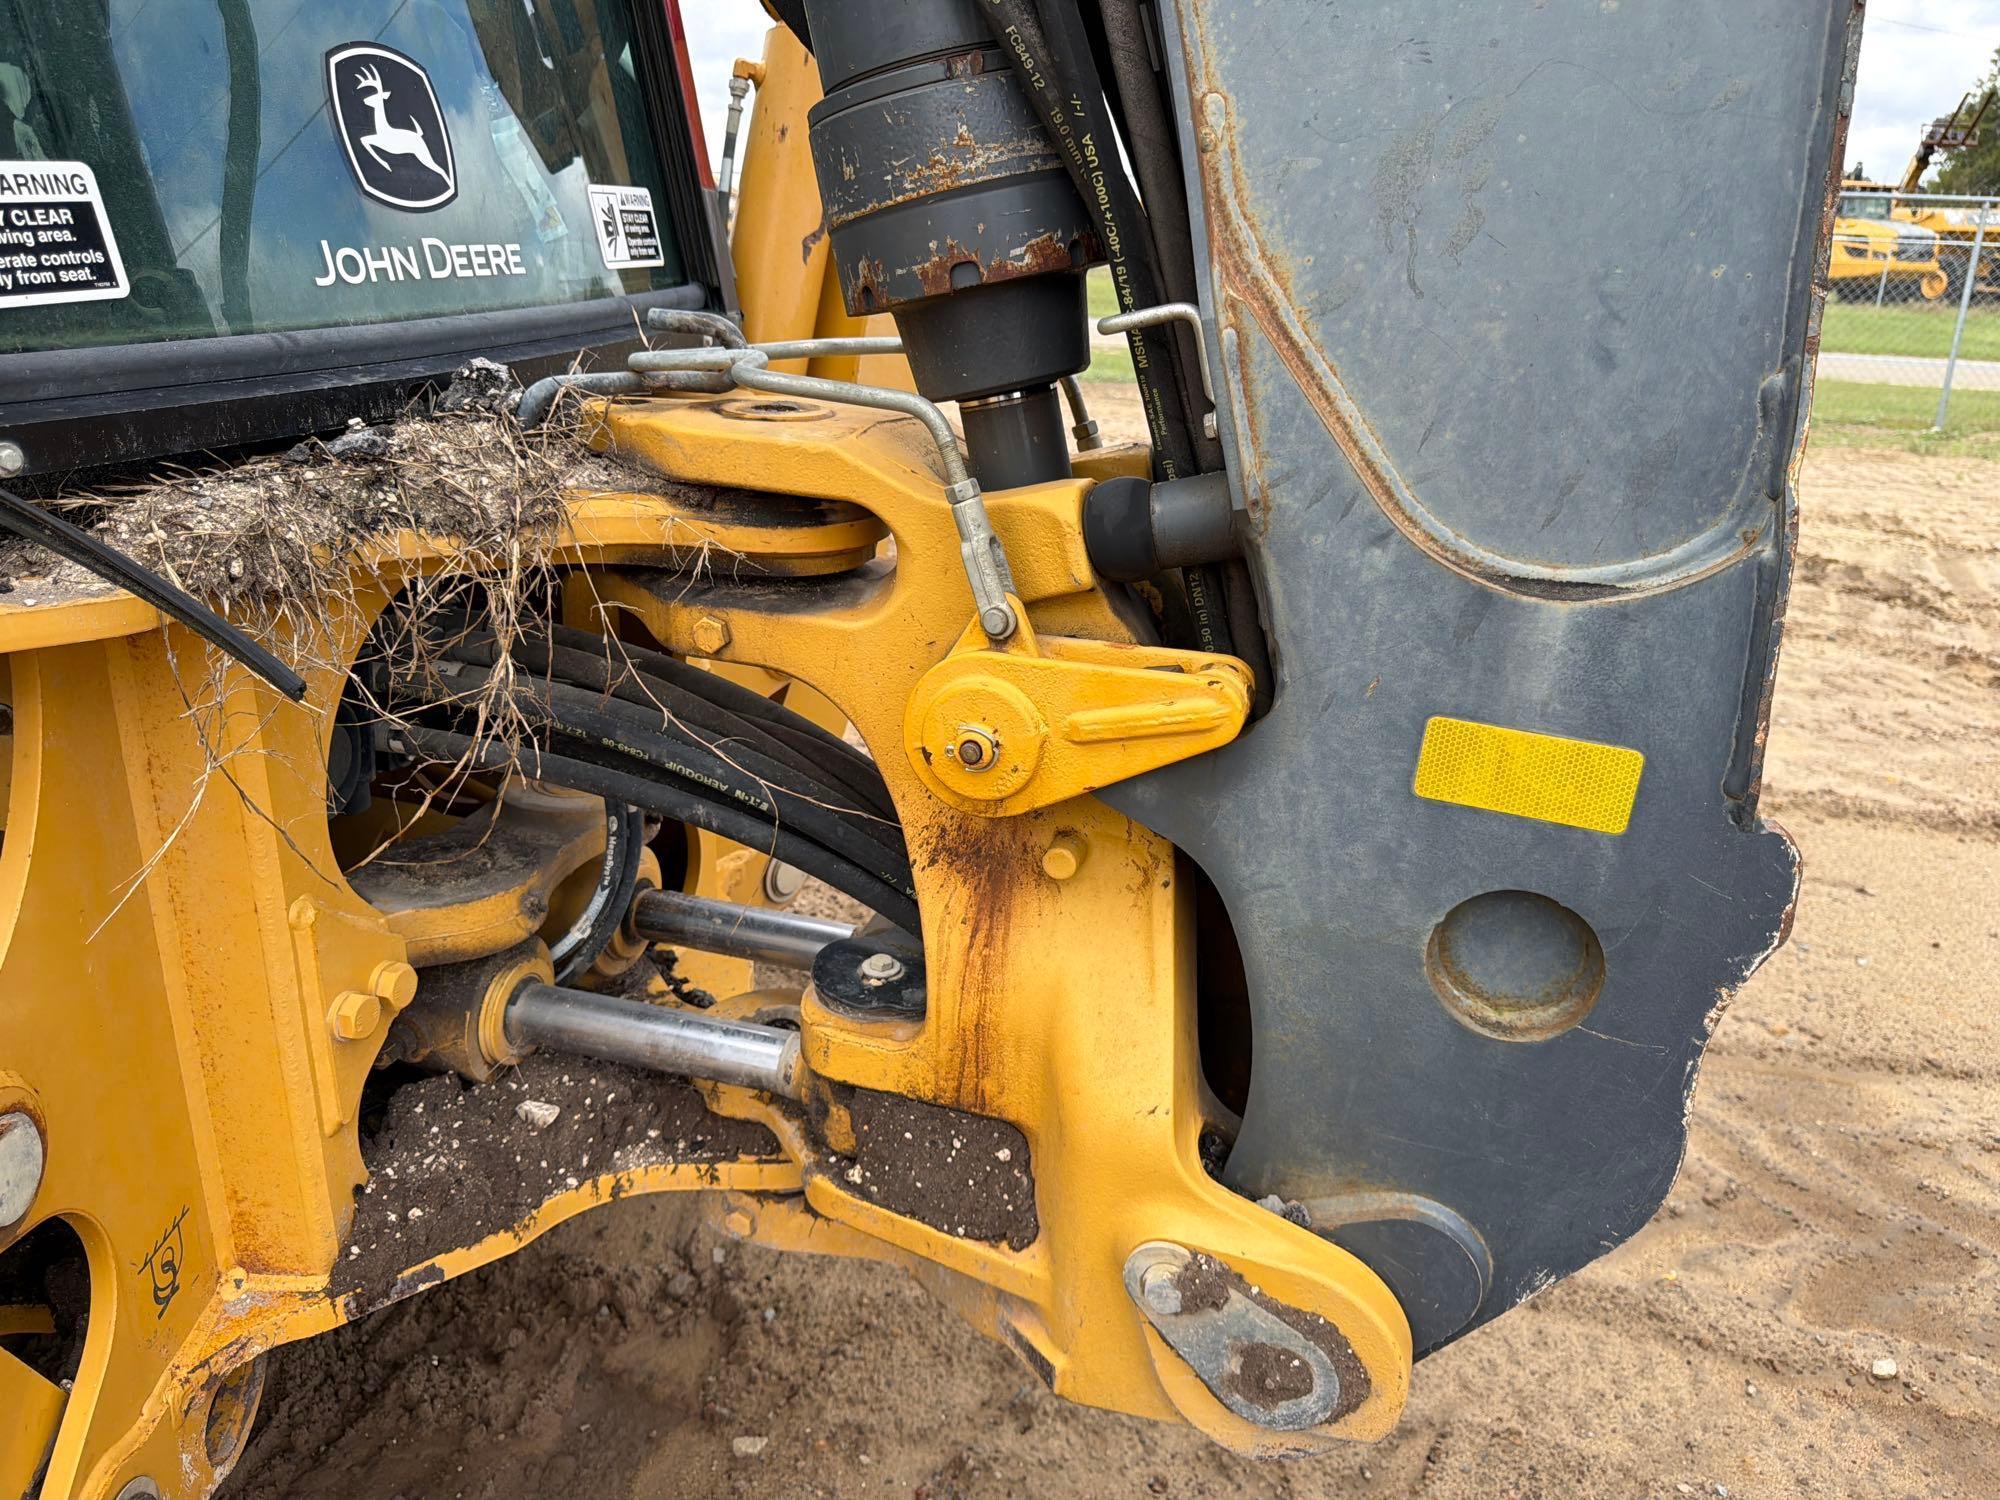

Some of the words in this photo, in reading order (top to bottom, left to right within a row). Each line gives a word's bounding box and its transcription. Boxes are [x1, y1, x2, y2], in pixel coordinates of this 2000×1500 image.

[1005, 25, 1045, 91] FC849-12
[1050, 106, 1070, 136] 19.0
[1065, 138, 1084, 163] mm
[1081, 133, 1099, 168] USA
[0, 173, 88, 195] ARNING
[10, 208, 74, 226] CLEAR
[0, 228, 35, 247] wing
[37, 230, 77, 243] area.
[0, 253, 37, 269] erate
[40, 249, 105, 266] controls
[315, 239, 421, 287] JOHN
[421, 237, 527, 279] DEERE
[16, 269, 56, 285] from
[59, 267, 97, 282] seat.
[1130, 328, 1148, 368] MSHA
[602, 737, 649, 760] FC849-08
[665, 761, 729, 792] AEROQUIP
